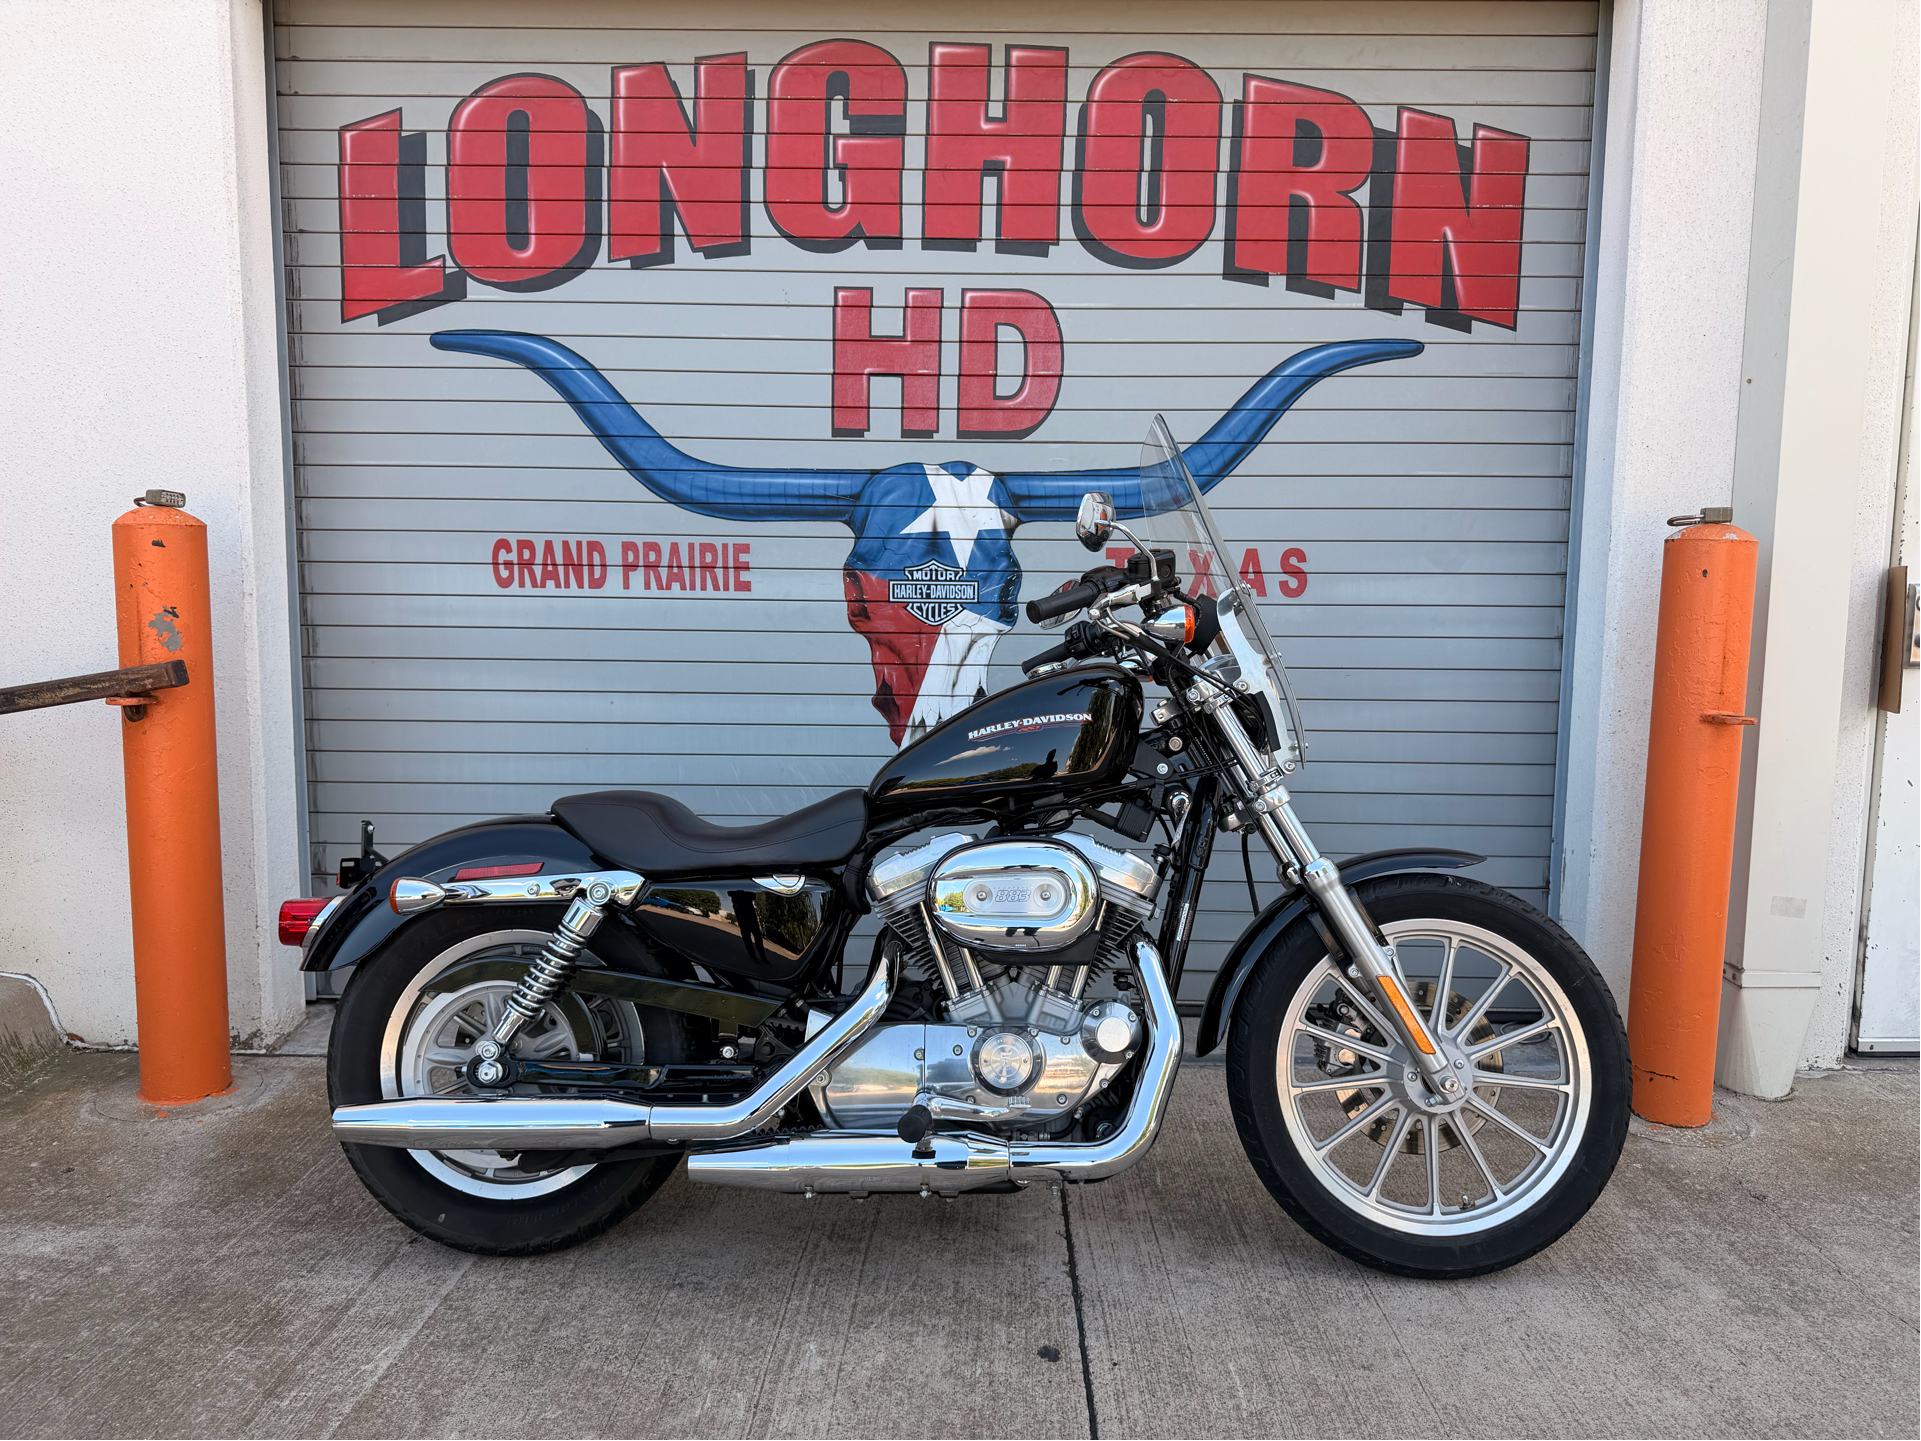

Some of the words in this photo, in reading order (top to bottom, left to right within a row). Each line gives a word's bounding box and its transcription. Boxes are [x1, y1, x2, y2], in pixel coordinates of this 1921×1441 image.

[338, 38, 1531, 334] LONGHORN
[831, 286, 1064, 439] HD
[491, 538, 608, 590] GRAND
[620, 541, 752, 592] PRAIRIE
[912, 564, 956, 580] MOTOR
[1105, 547, 1309, 599] TXAS
[893, 584, 974, 599] HARLEY-DAVIDSON
[913, 603, 956, 622] CYCLES
[995, 889, 1032, 903] 883
